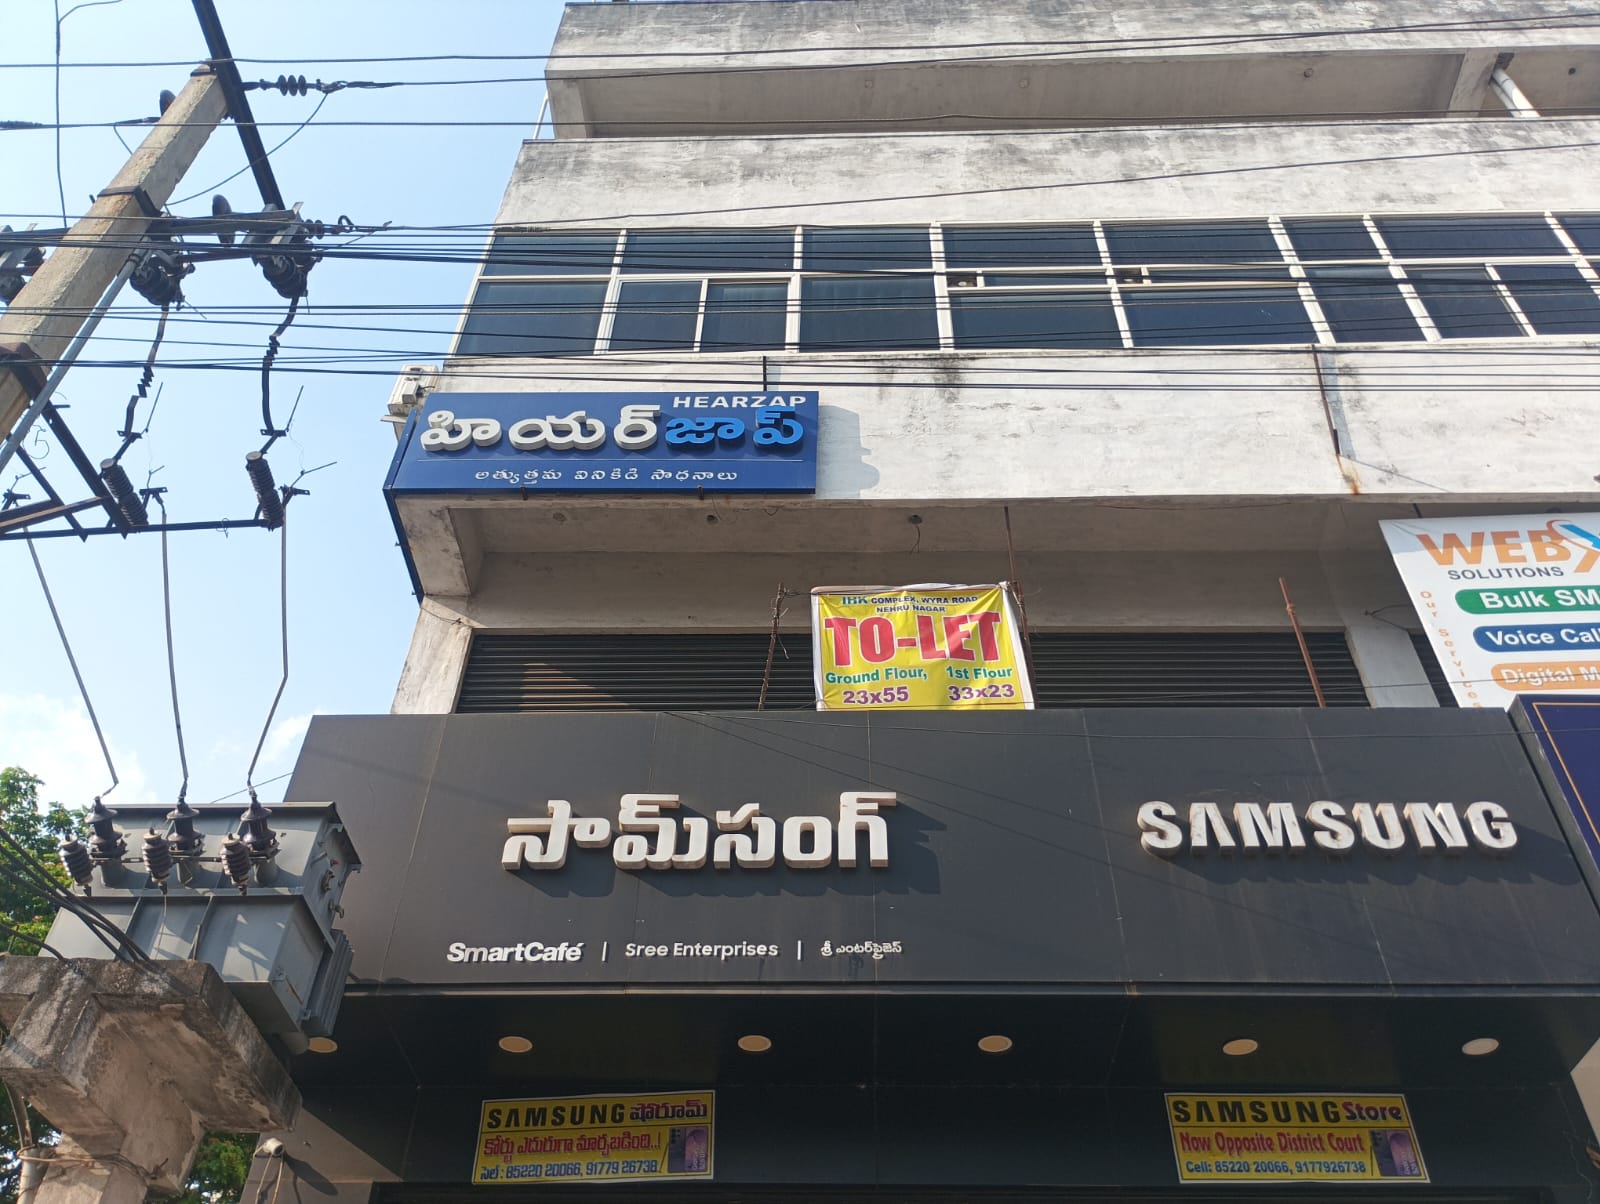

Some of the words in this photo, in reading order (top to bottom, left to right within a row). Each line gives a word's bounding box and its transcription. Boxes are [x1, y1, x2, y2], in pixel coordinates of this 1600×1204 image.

[672, 396, 807, 408] HEARZAP
[474, 469, 562, 485] అత్యుత్తమ
[574, 468, 639, 481] వినికిడి
[650, 468, 739, 483] సాధనాలు
[1447, 566, 1564, 580] SOLUTIONS
[922, 596, 949, 604] WYRA
[951, 596, 978, 604] ROAD
[1479, 590, 1549, 609] Bulk
[1554, 589, 1600, 606] SM
[876, 605, 909, 613] NEHRU
[824, 611, 1001, 667] TO-LET
[1485, 629, 1555, 646] Voice
[826, 668, 880, 684] Ground
[885, 667, 928, 681] Flour,
[946, 666, 969, 680] 1st
[974, 666, 1013, 680] Flour
[1500, 667, 1575, 685] Digital
[842, 686, 909, 704] 23x55
[948, 684, 1015, 701] 33x23
[1137, 800, 1518, 851] SAMSUNG
[447, 942, 584, 962] SmartCafé
[625, 942, 669, 957] Sree
[673, 942, 778, 961] Enterprises
[820, 940, 832, 956] శ్రీ
[486, 1103, 625, 1129] SAMSUNG
[1172, 1100, 1341, 1123] SAMSUNG
[1342, 1101, 1402, 1121] Store
[1179, 1131, 1211, 1153] Now
[1214, 1132, 1274, 1157] Opposite
[1276, 1132, 1324, 1153] District
[1327, 1132, 1365, 1152] Court
[506, 1164, 542, 1179] 85220
[545, 1162, 582, 1177] 20066,
[586, 1161, 618, 1175] 91779
[621, 1159, 658, 1173] 26738
[1185, 1161, 1212, 1173] Cell:
[1215, 1161, 1250, 1173] 85220
[1254, 1161, 1294, 1176] 20066,
[1295, 1161, 1366, 1173] 9177926738
